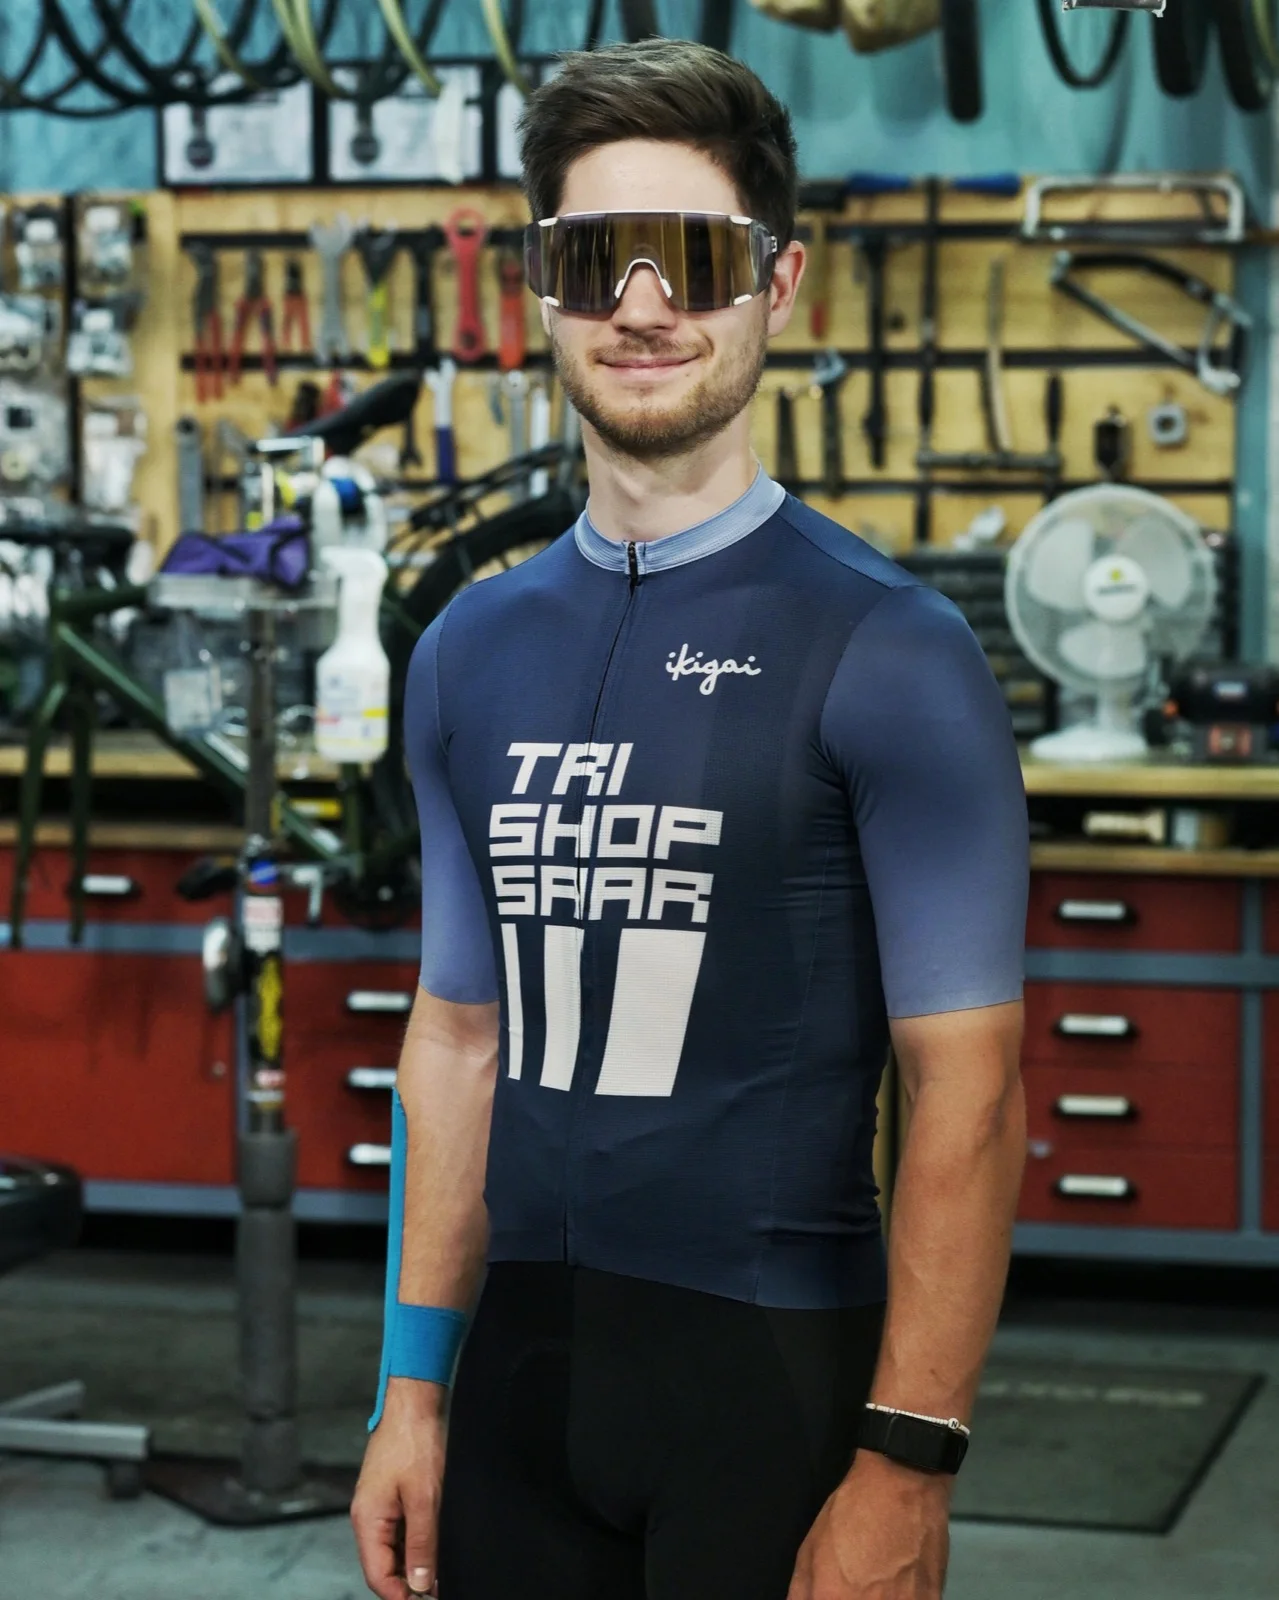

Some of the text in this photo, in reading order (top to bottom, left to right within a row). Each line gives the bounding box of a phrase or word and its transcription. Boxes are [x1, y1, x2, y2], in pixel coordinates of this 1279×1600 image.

[666, 643, 762, 695] ikigai
[507, 742, 634, 796] TRI
[489, 803, 724, 860] SHOP
[492, 865, 714, 923] SAAR
